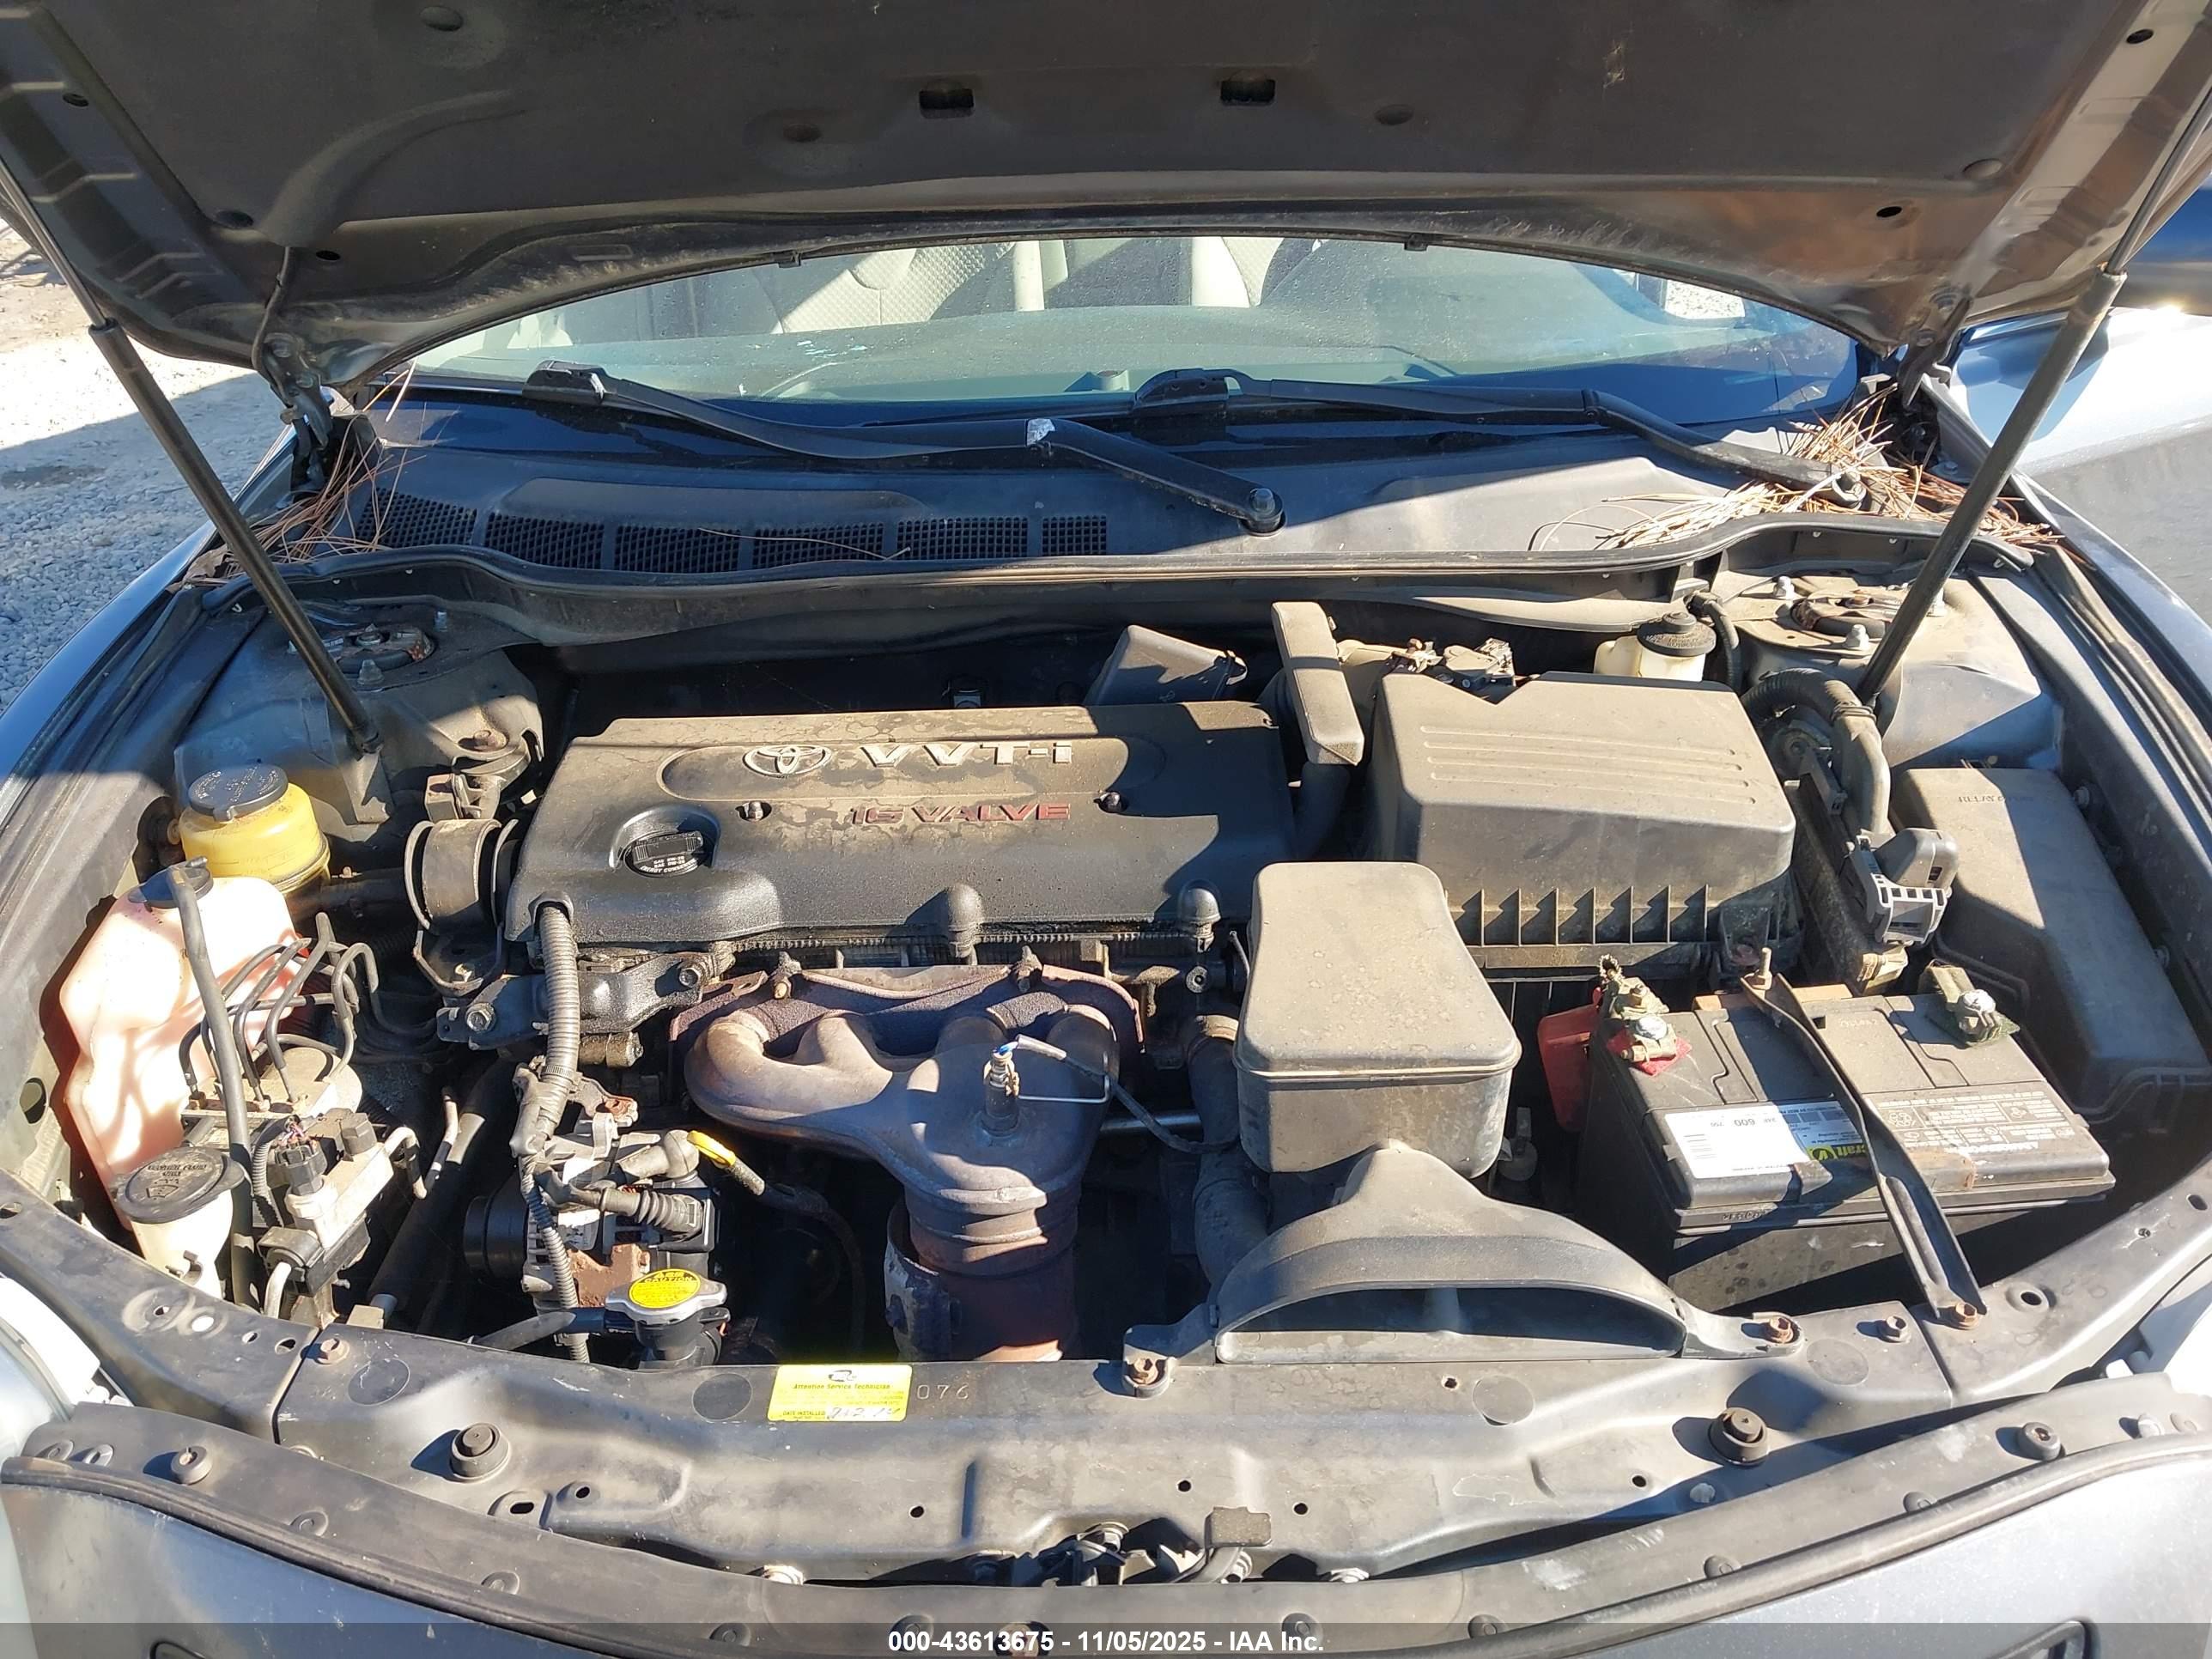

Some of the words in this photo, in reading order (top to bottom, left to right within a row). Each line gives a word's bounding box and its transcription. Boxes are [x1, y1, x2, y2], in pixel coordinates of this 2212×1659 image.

[860, 742, 1073, 768] VVT-i
[849, 805, 905, 825] 16
[912, 803, 1072, 823] VALVE
[1733, 1118, 1756, 1127] 600
[915, 1382, 970, 1401] 076
